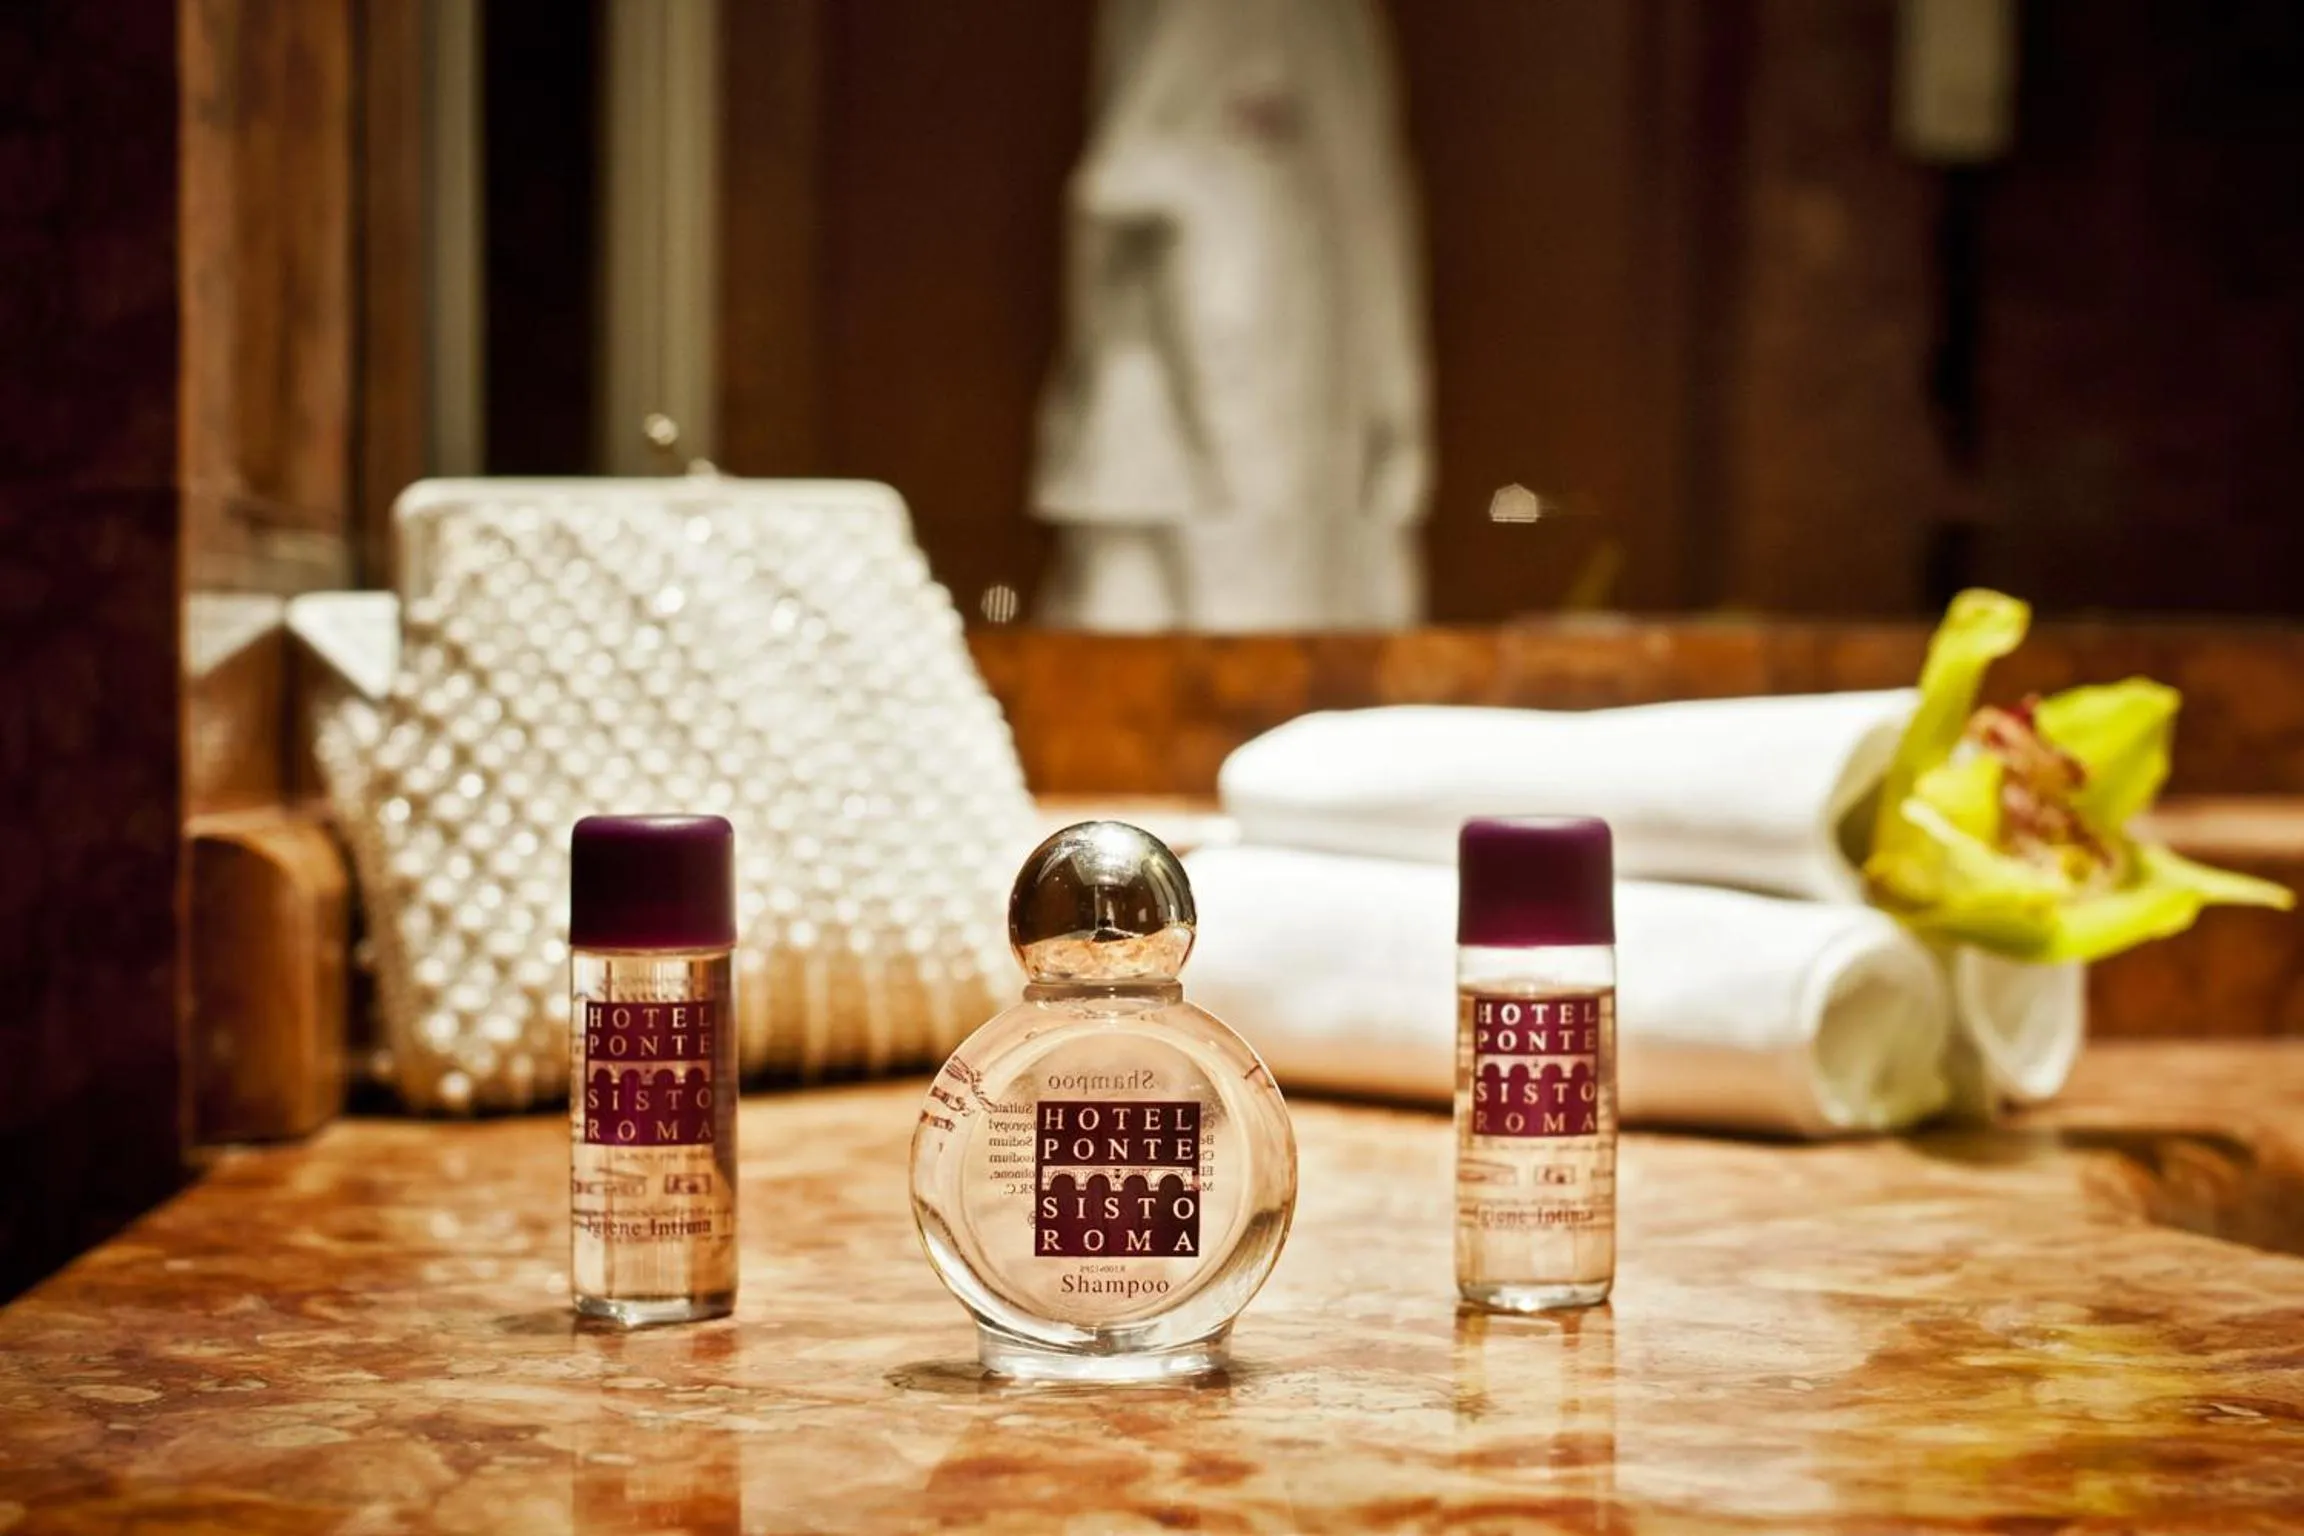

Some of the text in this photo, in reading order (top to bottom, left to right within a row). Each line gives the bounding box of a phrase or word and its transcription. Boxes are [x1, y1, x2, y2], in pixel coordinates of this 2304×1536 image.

[589, 1007, 711, 1028] HOTEL
[1478, 1003, 1595, 1025] HOTEL
[588, 1034, 711, 1056] PONTE
[1478, 1030, 1596, 1051] PONTE
[588, 1087, 712, 1111] SISTO
[1476, 1081, 1596, 1104] SISTO
[588, 1118, 712, 1141] ROMA
[1044, 1107, 1193, 1130] HOTEL
[1476, 1111, 1595, 1133] ROMA
[1043, 1138, 1194, 1160] PONTE
[1042, 1197, 1195, 1219] SISTO
[1042, 1229, 1195, 1251] ROMA
[1061, 1274, 1170, 1298] Shampoo
